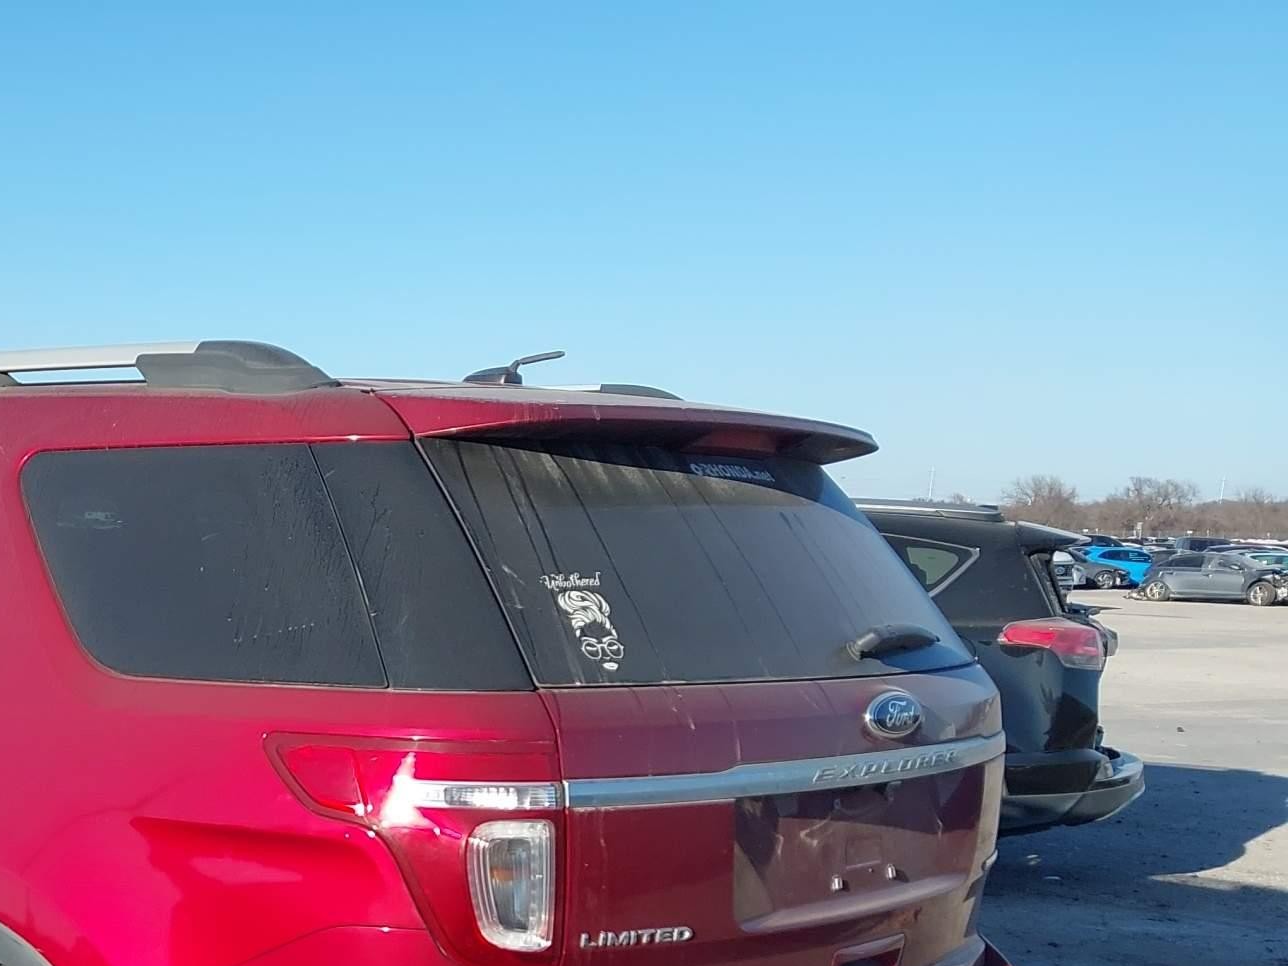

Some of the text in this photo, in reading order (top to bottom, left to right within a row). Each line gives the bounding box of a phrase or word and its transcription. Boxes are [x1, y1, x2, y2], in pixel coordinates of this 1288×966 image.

[538, 571, 601, 592] Unbothered
[886, 700, 918, 728] Ford
[812, 749, 959, 785] EXPLORER
[579, 926, 693, 948] LIMITED
